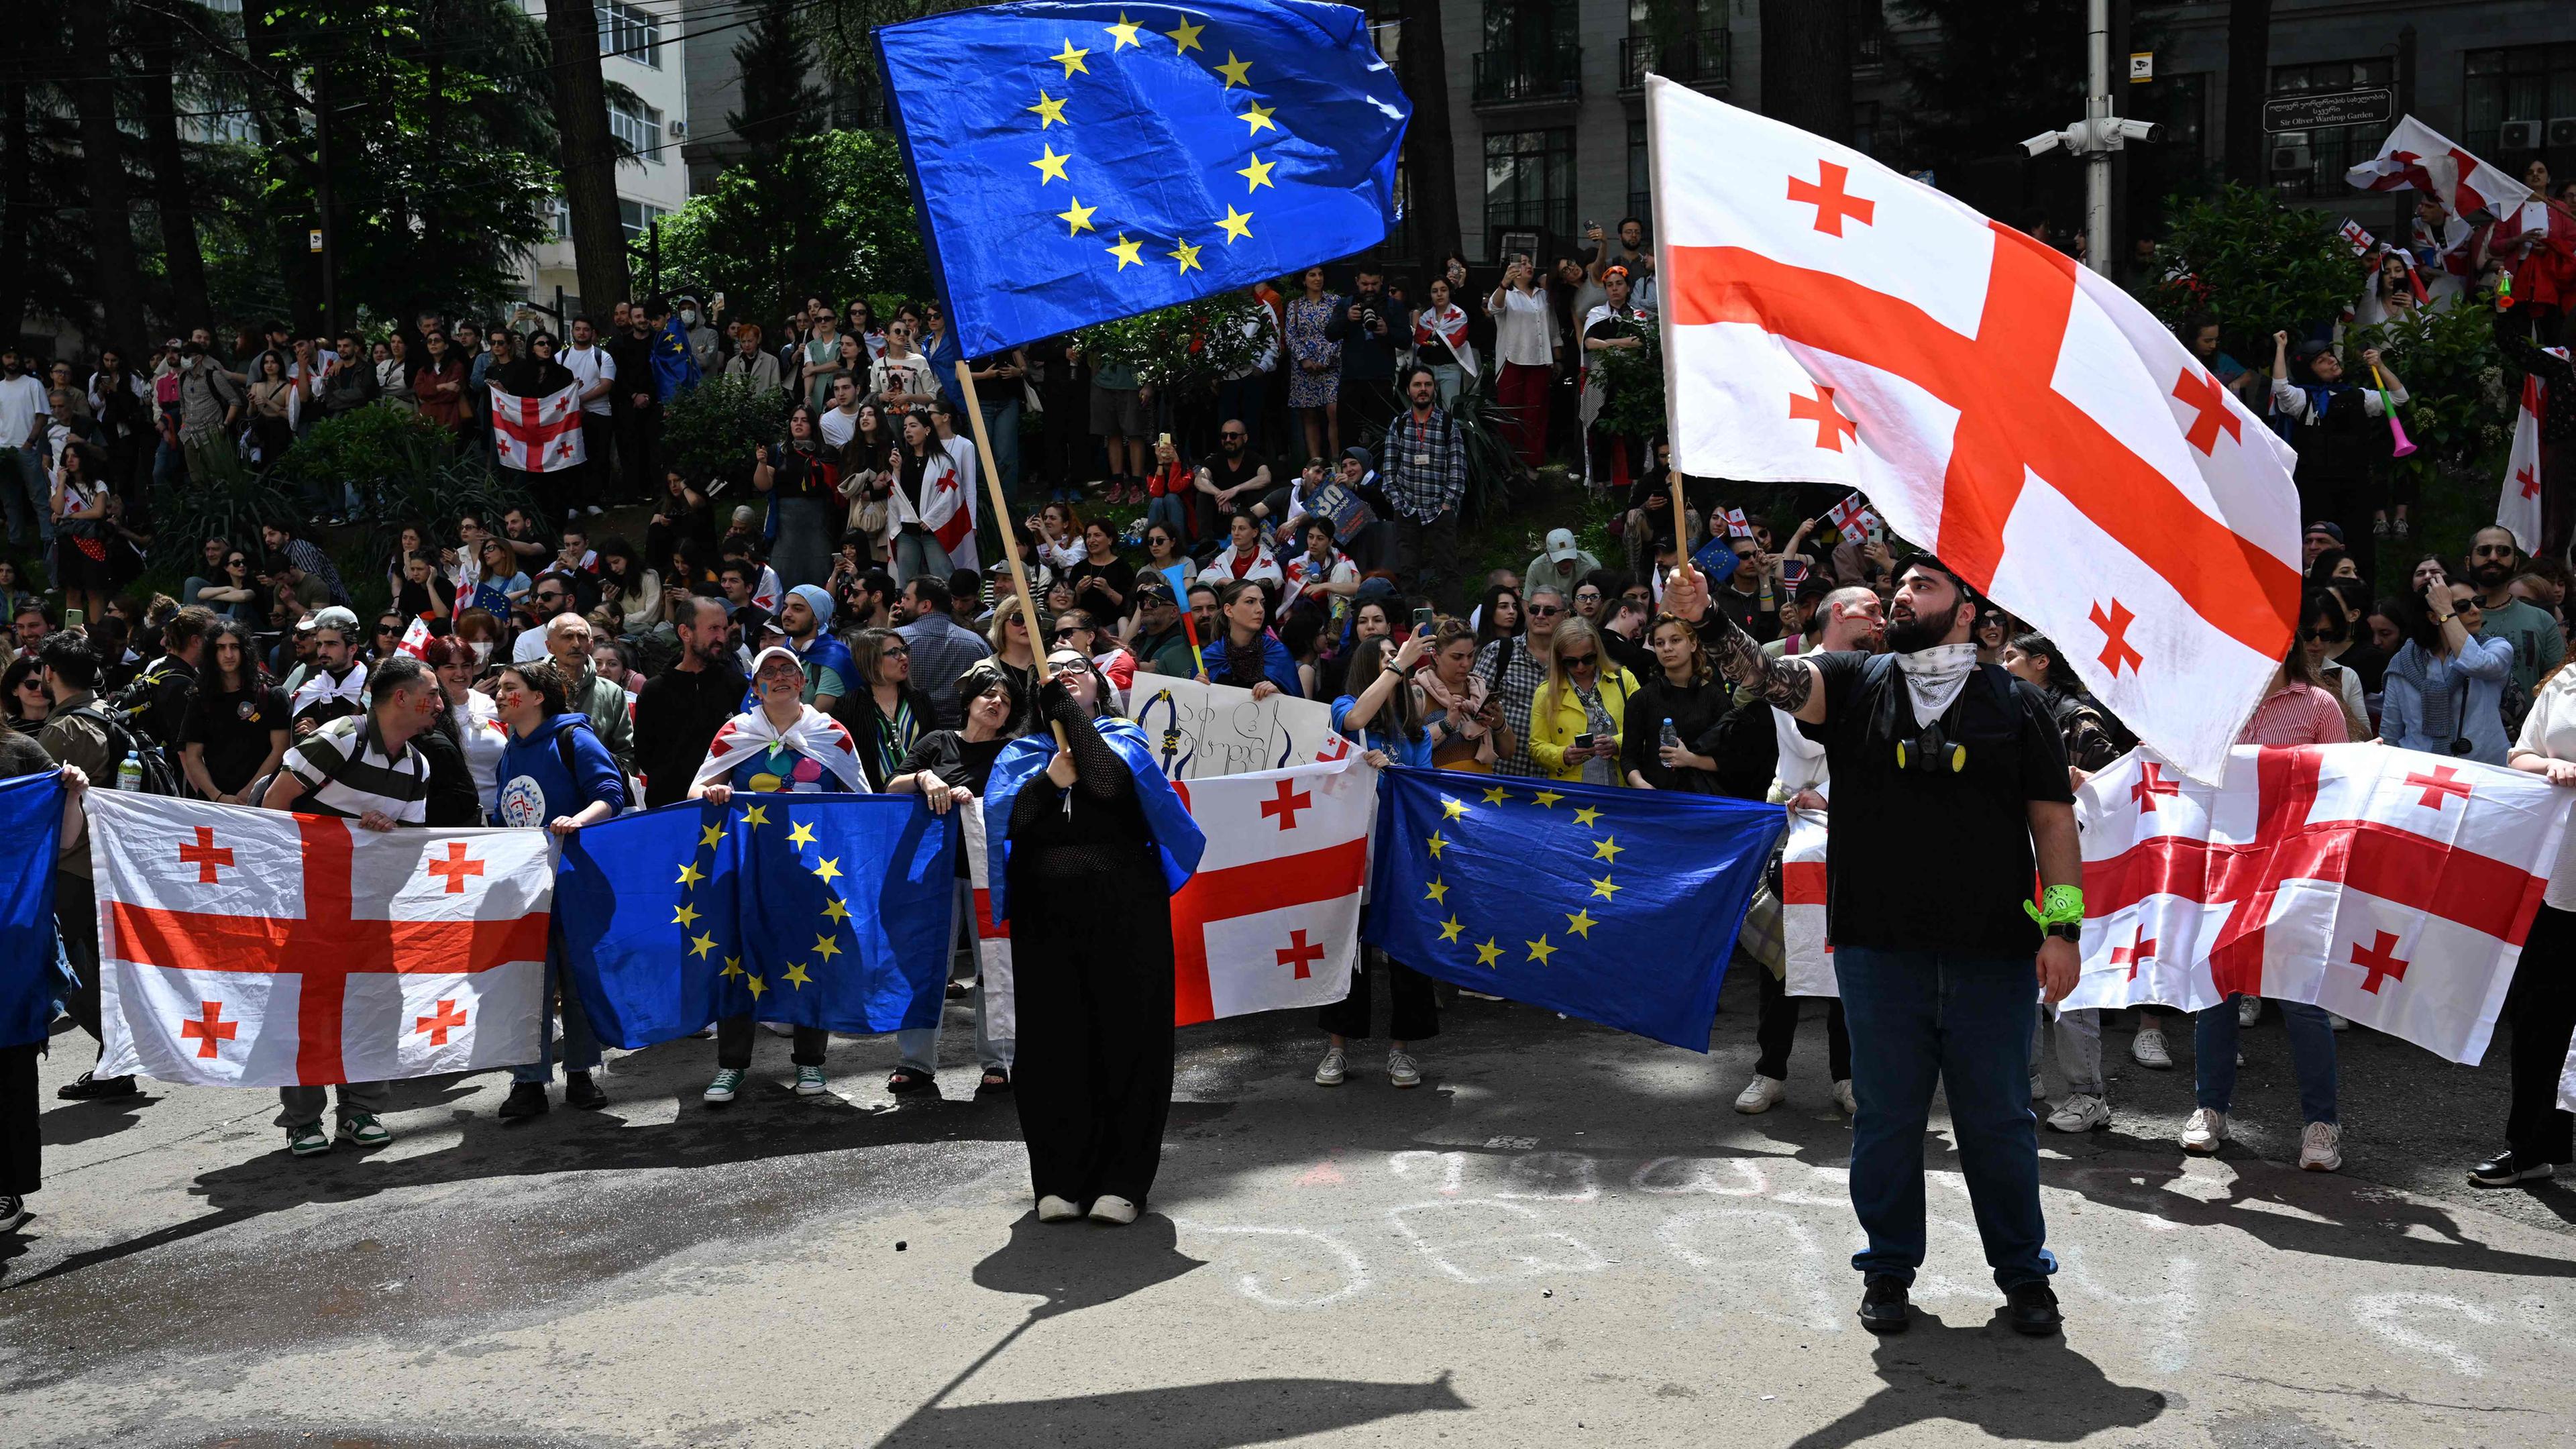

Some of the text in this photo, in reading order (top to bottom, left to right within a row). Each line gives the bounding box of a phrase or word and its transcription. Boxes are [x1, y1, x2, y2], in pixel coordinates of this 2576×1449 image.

[2269, 101, 2299, 112] ოლივერ
[2315, 114, 2346, 122] Wardrop
[2347, 111, 2373, 119] Garden
